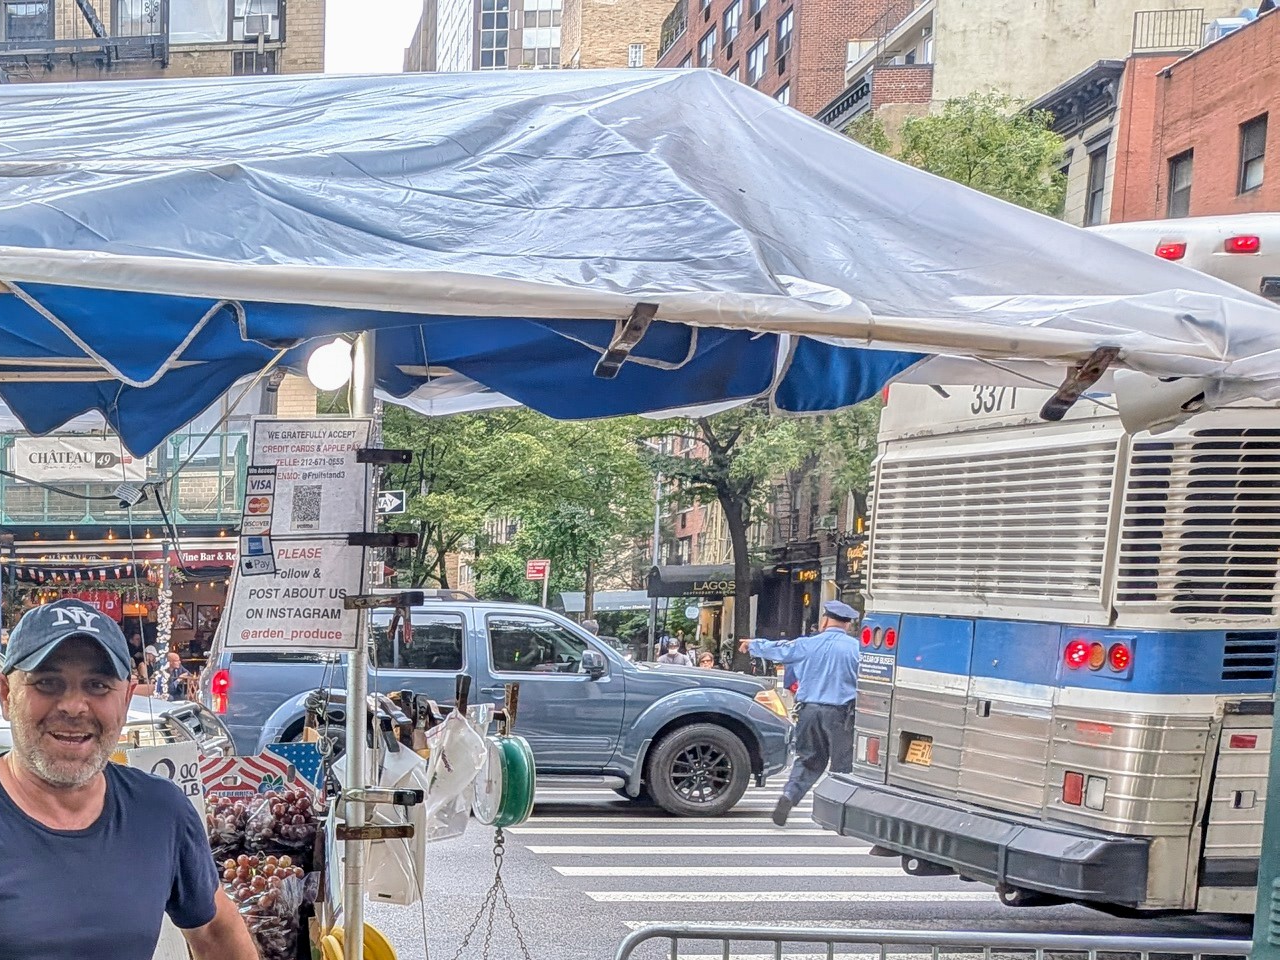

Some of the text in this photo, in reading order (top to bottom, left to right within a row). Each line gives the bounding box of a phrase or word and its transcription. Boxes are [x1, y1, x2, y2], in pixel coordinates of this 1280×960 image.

[267, 430, 356, 440] WE GRATEFULLY ACCEPT
[262, 444, 288, 454] CREDIT
[290, 444, 315, 453] CARDS
[322, 443, 345, 453] APPLE
[346, 443, 361, 452] PAY
[28, 449, 111, 466] CHÂTEAU 49
[276, 471, 300, 481] ENMO:
[250, 479, 272, 491] VISA
[243, 519, 270, 528] DISCOVER
[200, 552, 224, 561] Bar &
[277, 547, 322, 560] PLEASE
[254, 559, 271, 570] Pay
[274, 568, 322, 580] Follow &
[693, 580, 736, 591] LAGOS
[248, 588, 347, 600] POST ABOUT US
[245, 608, 342, 620] ON INSTAGRAM
[240, 628, 343, 641] @arden_produce
